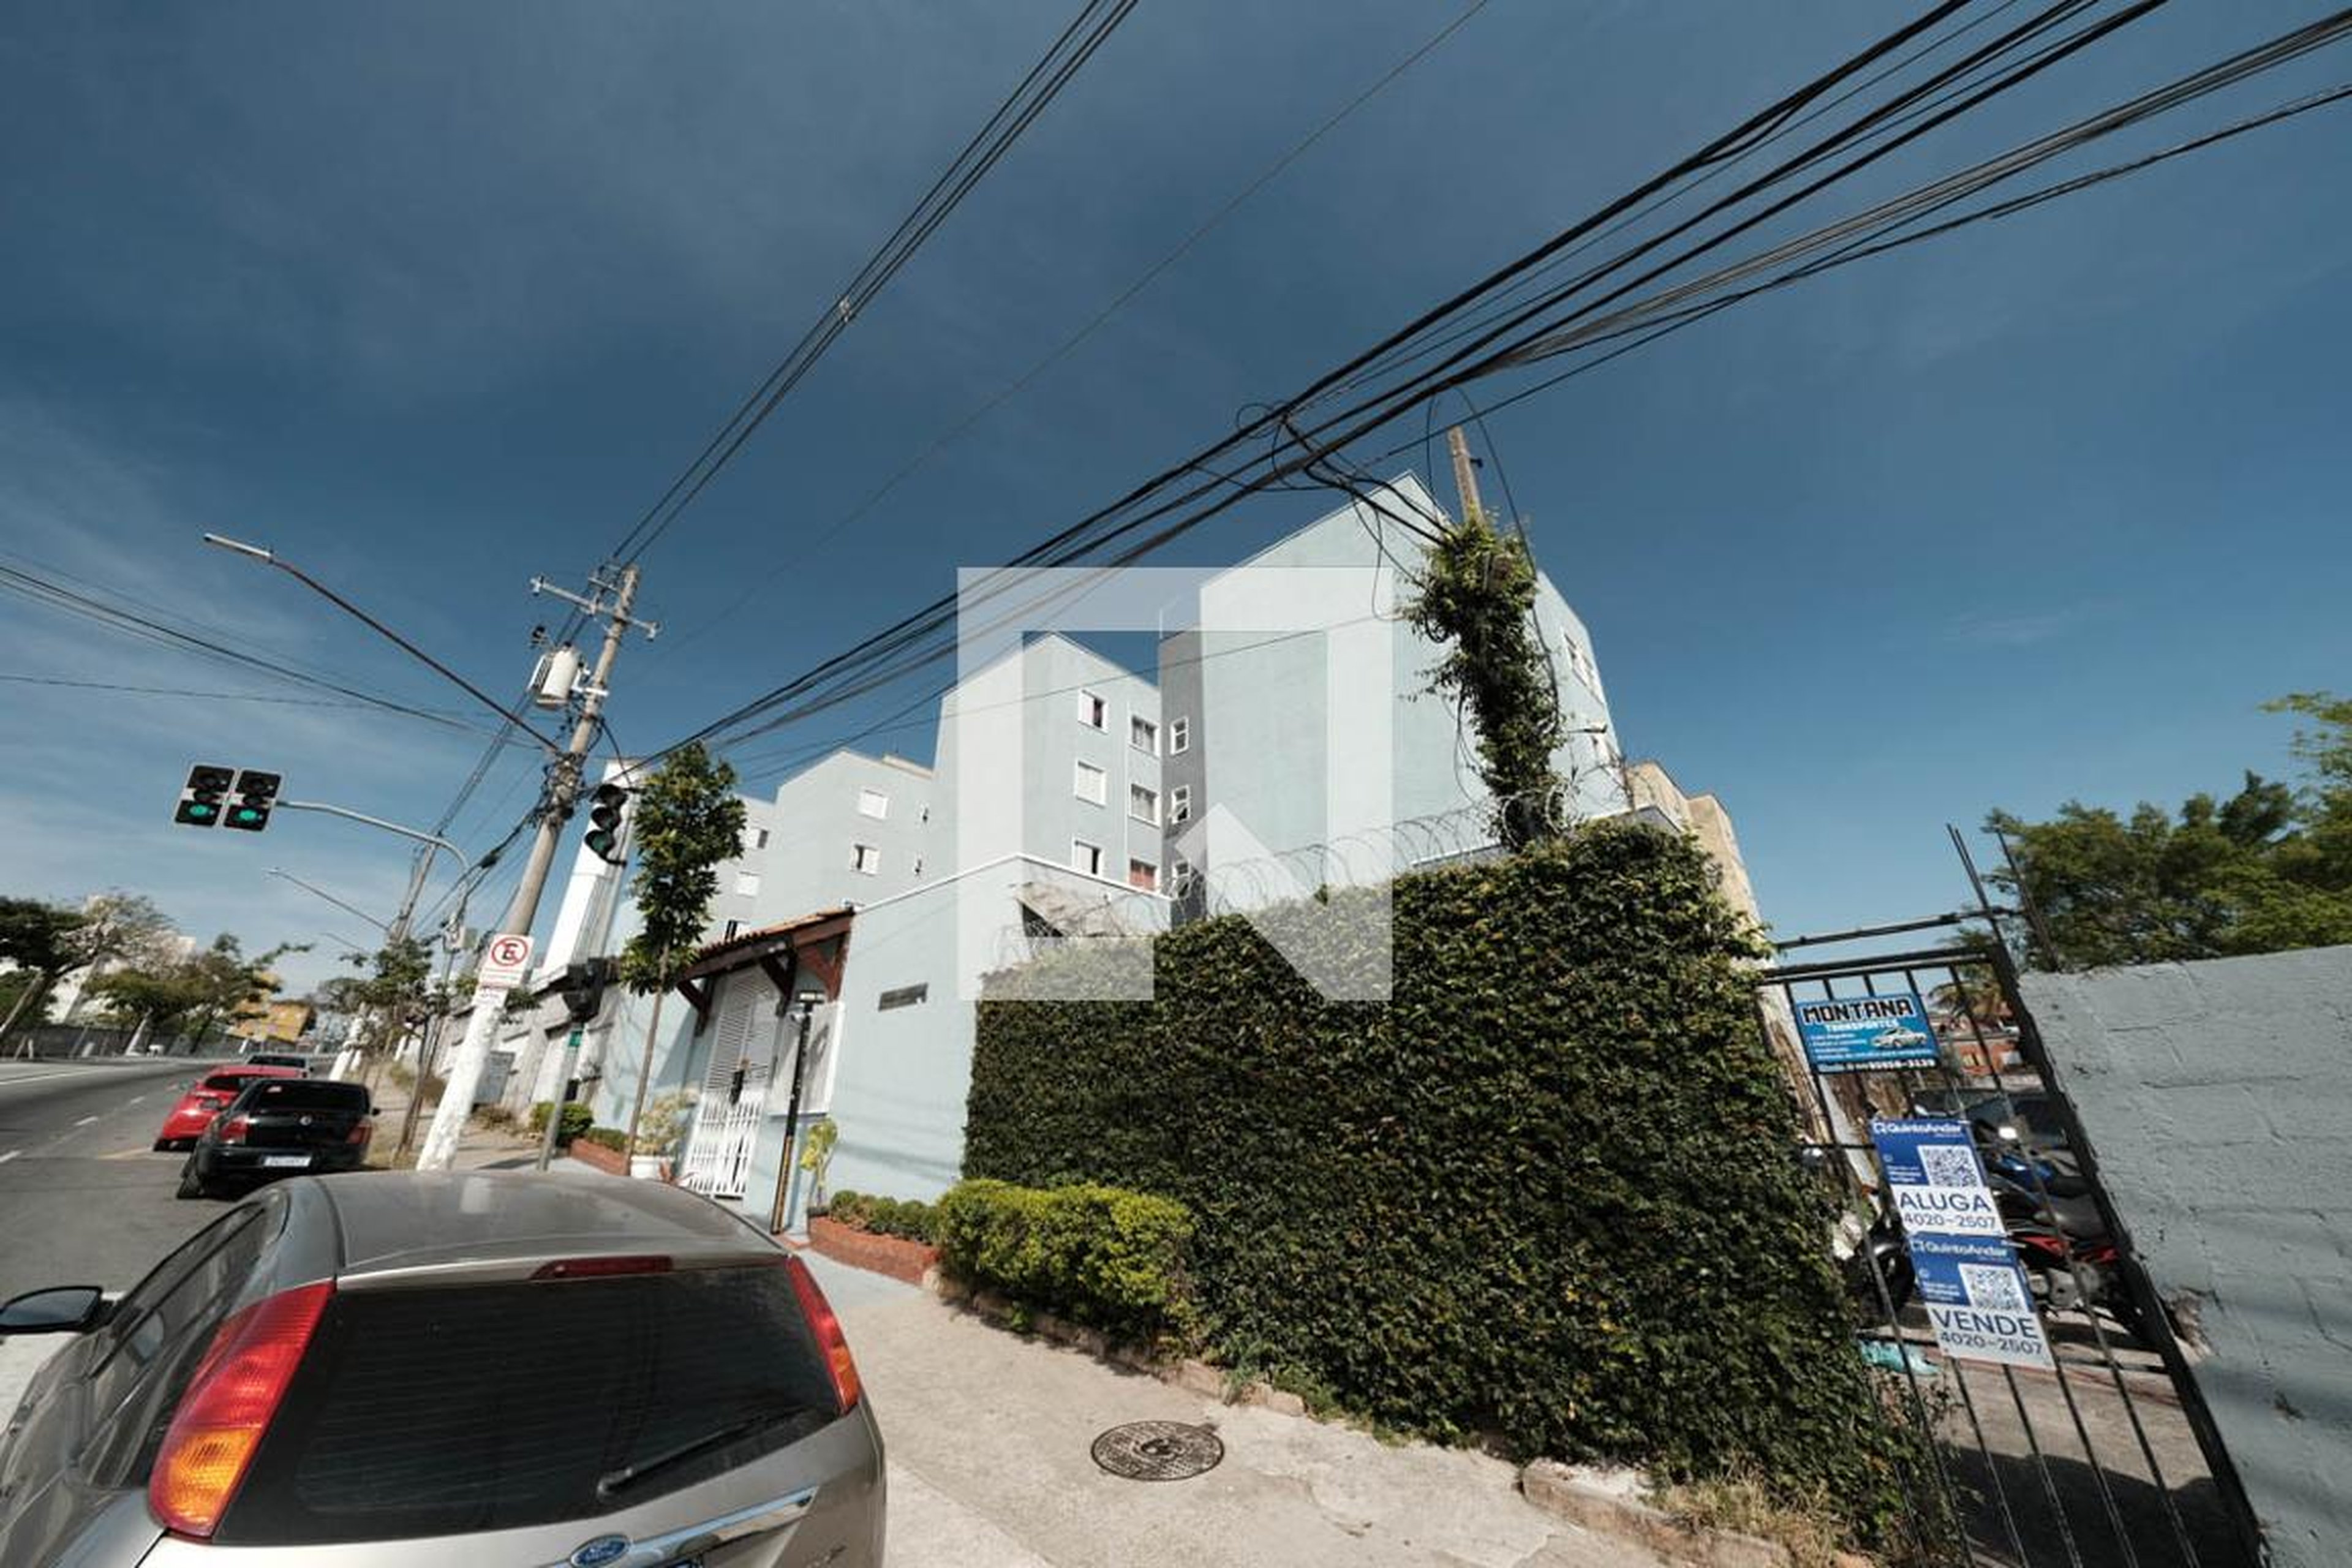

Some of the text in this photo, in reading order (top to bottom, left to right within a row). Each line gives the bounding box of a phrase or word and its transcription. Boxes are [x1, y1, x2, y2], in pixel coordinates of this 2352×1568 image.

[1803, 998, 1914, 1023] MONTANA
[1888, 1121, 1961, 1133] QuintoAndar
[1900, 1191, 1991, 1212] ALUGA
[1904, 1213, 1996, 1229] 4020-2507
[1925, 1241, 2008, 1256] QuintoAndar
[1931, 1308, 2038, 1340] VENDE
[1940, 1332, 2043, 1355] 4020-2507
